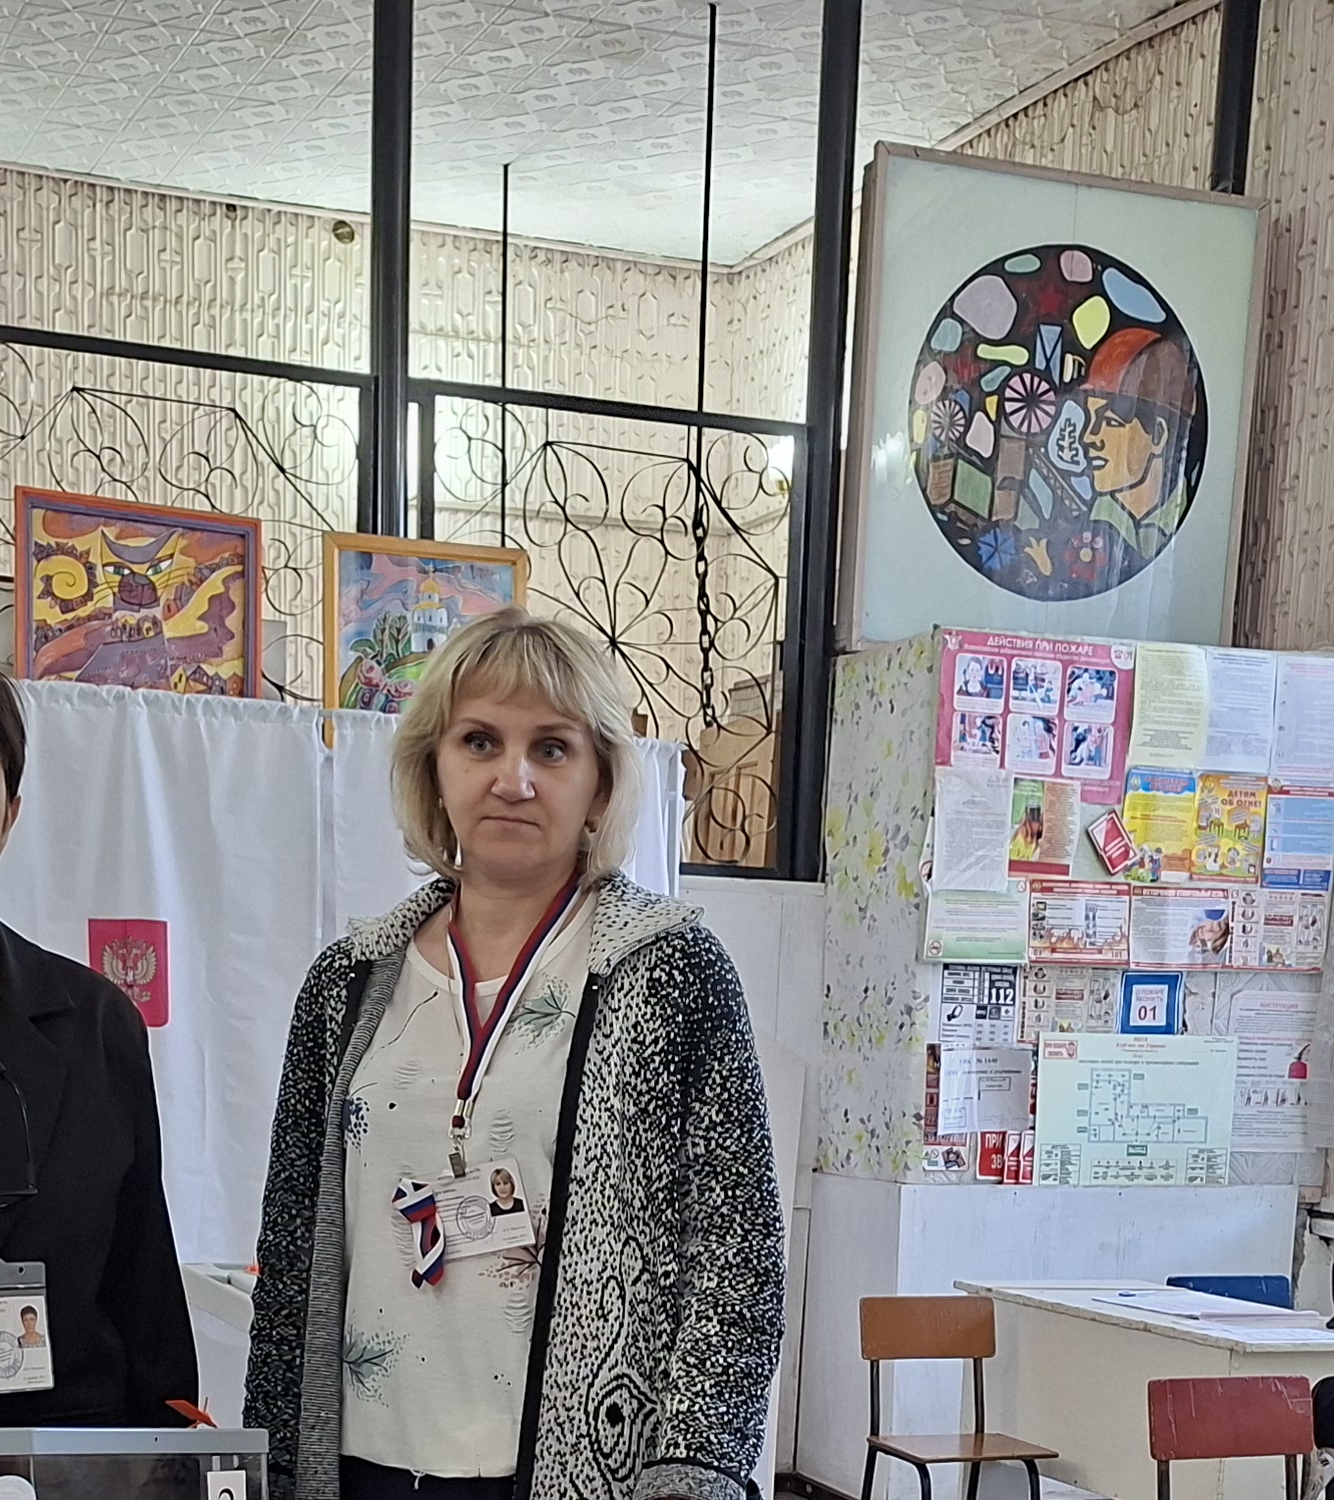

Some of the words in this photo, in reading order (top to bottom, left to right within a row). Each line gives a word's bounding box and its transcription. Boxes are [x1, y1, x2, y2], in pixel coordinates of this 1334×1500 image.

[986, 636, 1033, 650] ДЕЙСТВИЯ
[1035, 639, 1054, 652] ПРИ
[1055, 642, 1094, 656] ПОЖАРЕ
[1227, 790, 1257, 799] ДЕТЯМ
[1220, 798, 1235, 807] ОБ
[1236, 799, 1262, 809] ОГНЕ!
[990, 987, 1014, 1005] 112
[1138, 1005, 1157, 1021] 01
[985, 1133, 1003, 1149] ПРИ
